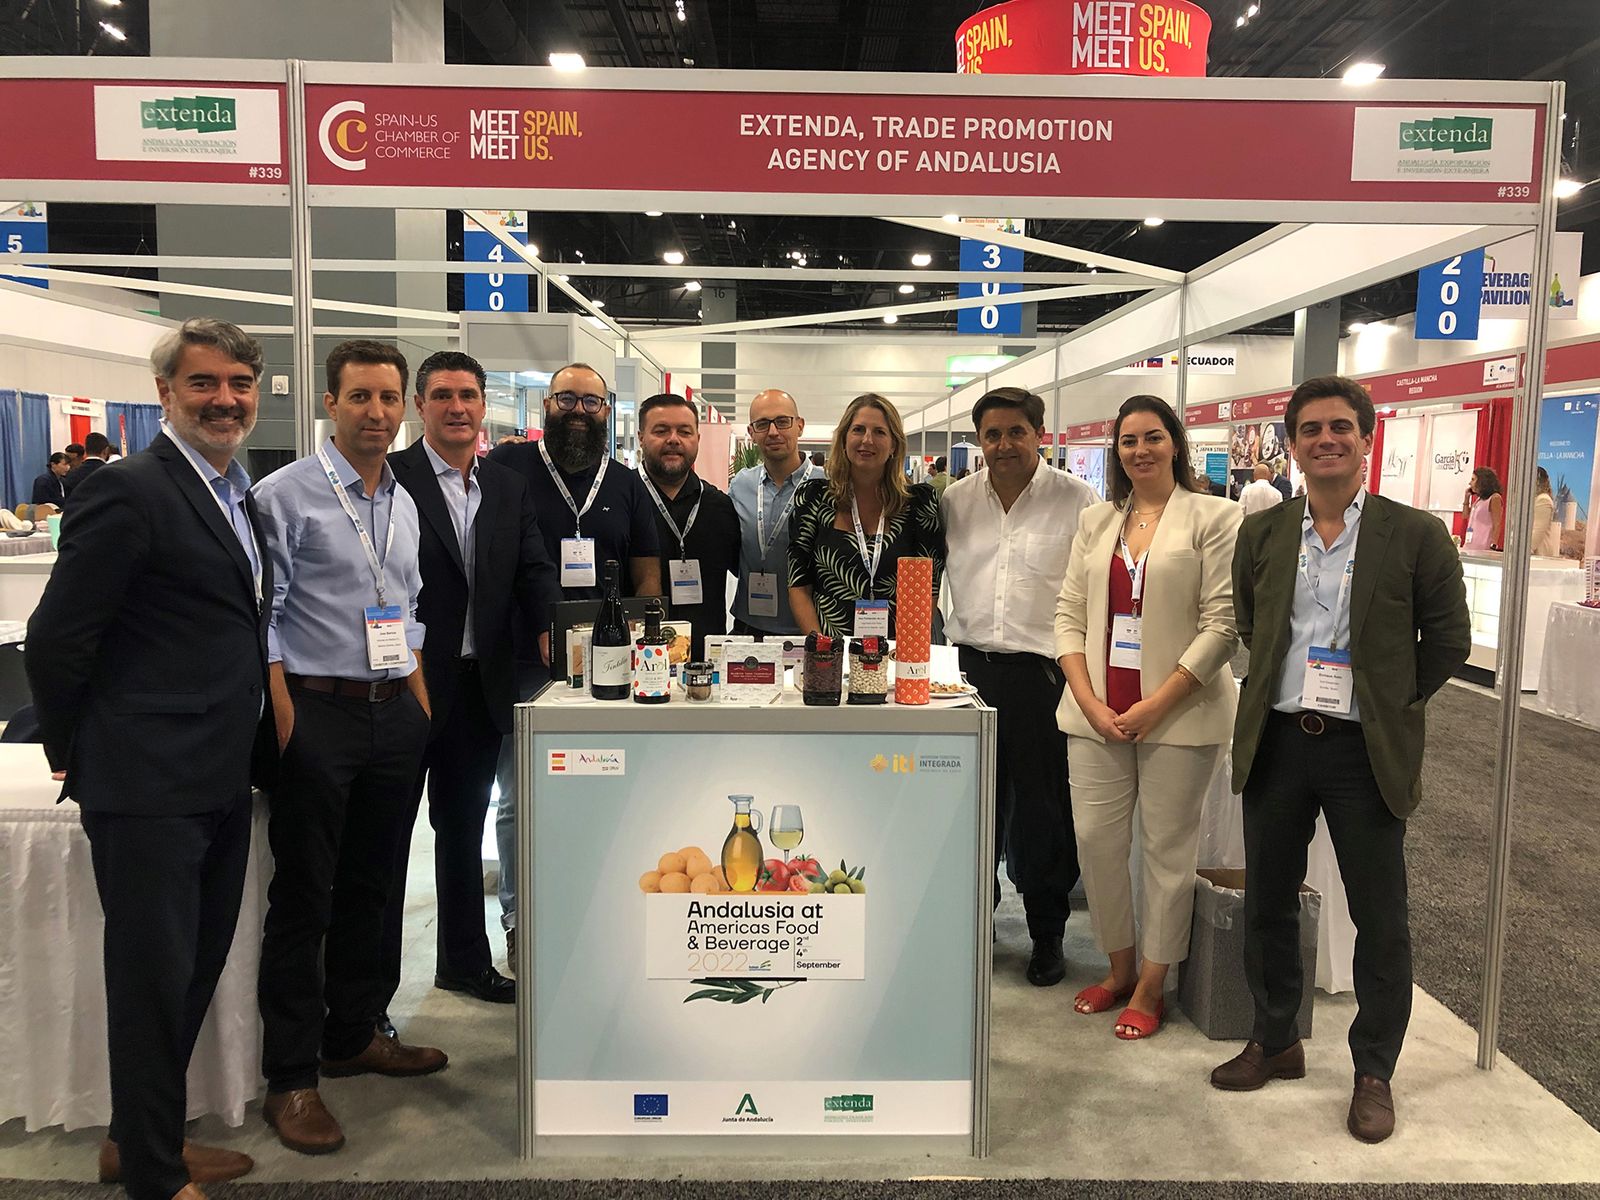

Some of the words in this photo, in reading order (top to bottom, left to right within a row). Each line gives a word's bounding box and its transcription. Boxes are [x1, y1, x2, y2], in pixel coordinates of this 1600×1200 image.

[1072, 2, 1135, 35] MEET
[1139, 4, 1192, 50] SPAIN,
[966, 14, 1014, 61] SPAIN,
[1071, 36, 1134, 69] MEET
[1139, 38, 1170, 74] US.
[143, 103, 233, 124] extenda
[375, 113, 438, 127] SPAIN-US
[470, 109, 520, 134] MEET
[523, 110, 583, 137] SPAIN,
[740, 114, 865, 142] EXTENDA,
[872, 116, 957, 140] TRADE
[965, 117, 1114, 142] PROMOTION
[375, 130, 439, 144] CHAMBER
[442, 131, 461, 144] OF
[1402, 122, 1489, 143] extenda
[375, 146, 451, 159] COMMERCE
[470, 134, 520, 160] MEET
[524, 136, 554, 160] US.
[767, 147, 871, 171] AGENCY
[877, 149, 910, 172] OF
[916, 150, 1062, 174] ANDALUSIA
[248, 166, 282, 179] #339
[1497, 186, 1530, 198] #339
[1482, 272, 1532, 287] EVERAG
[1438, 255, 1462, 335] 200
[1187, 357, 1234, 366] ECUADOR
[919, 760, 961, 768] INTEGRADA
[687, 901, 794, 918] Andalusia
[801, 903, 824, 918] at
[687, 920, 770, 934] Americas
[776, 920, 819, 934] Food
[687, 935, 699, 950] &
[705, 936, 790, 953] Beverage
[687, 952, 748, 972] 2022
[796, 961, 841, 970] September
[825, 1097, 871, 1108] extenda
